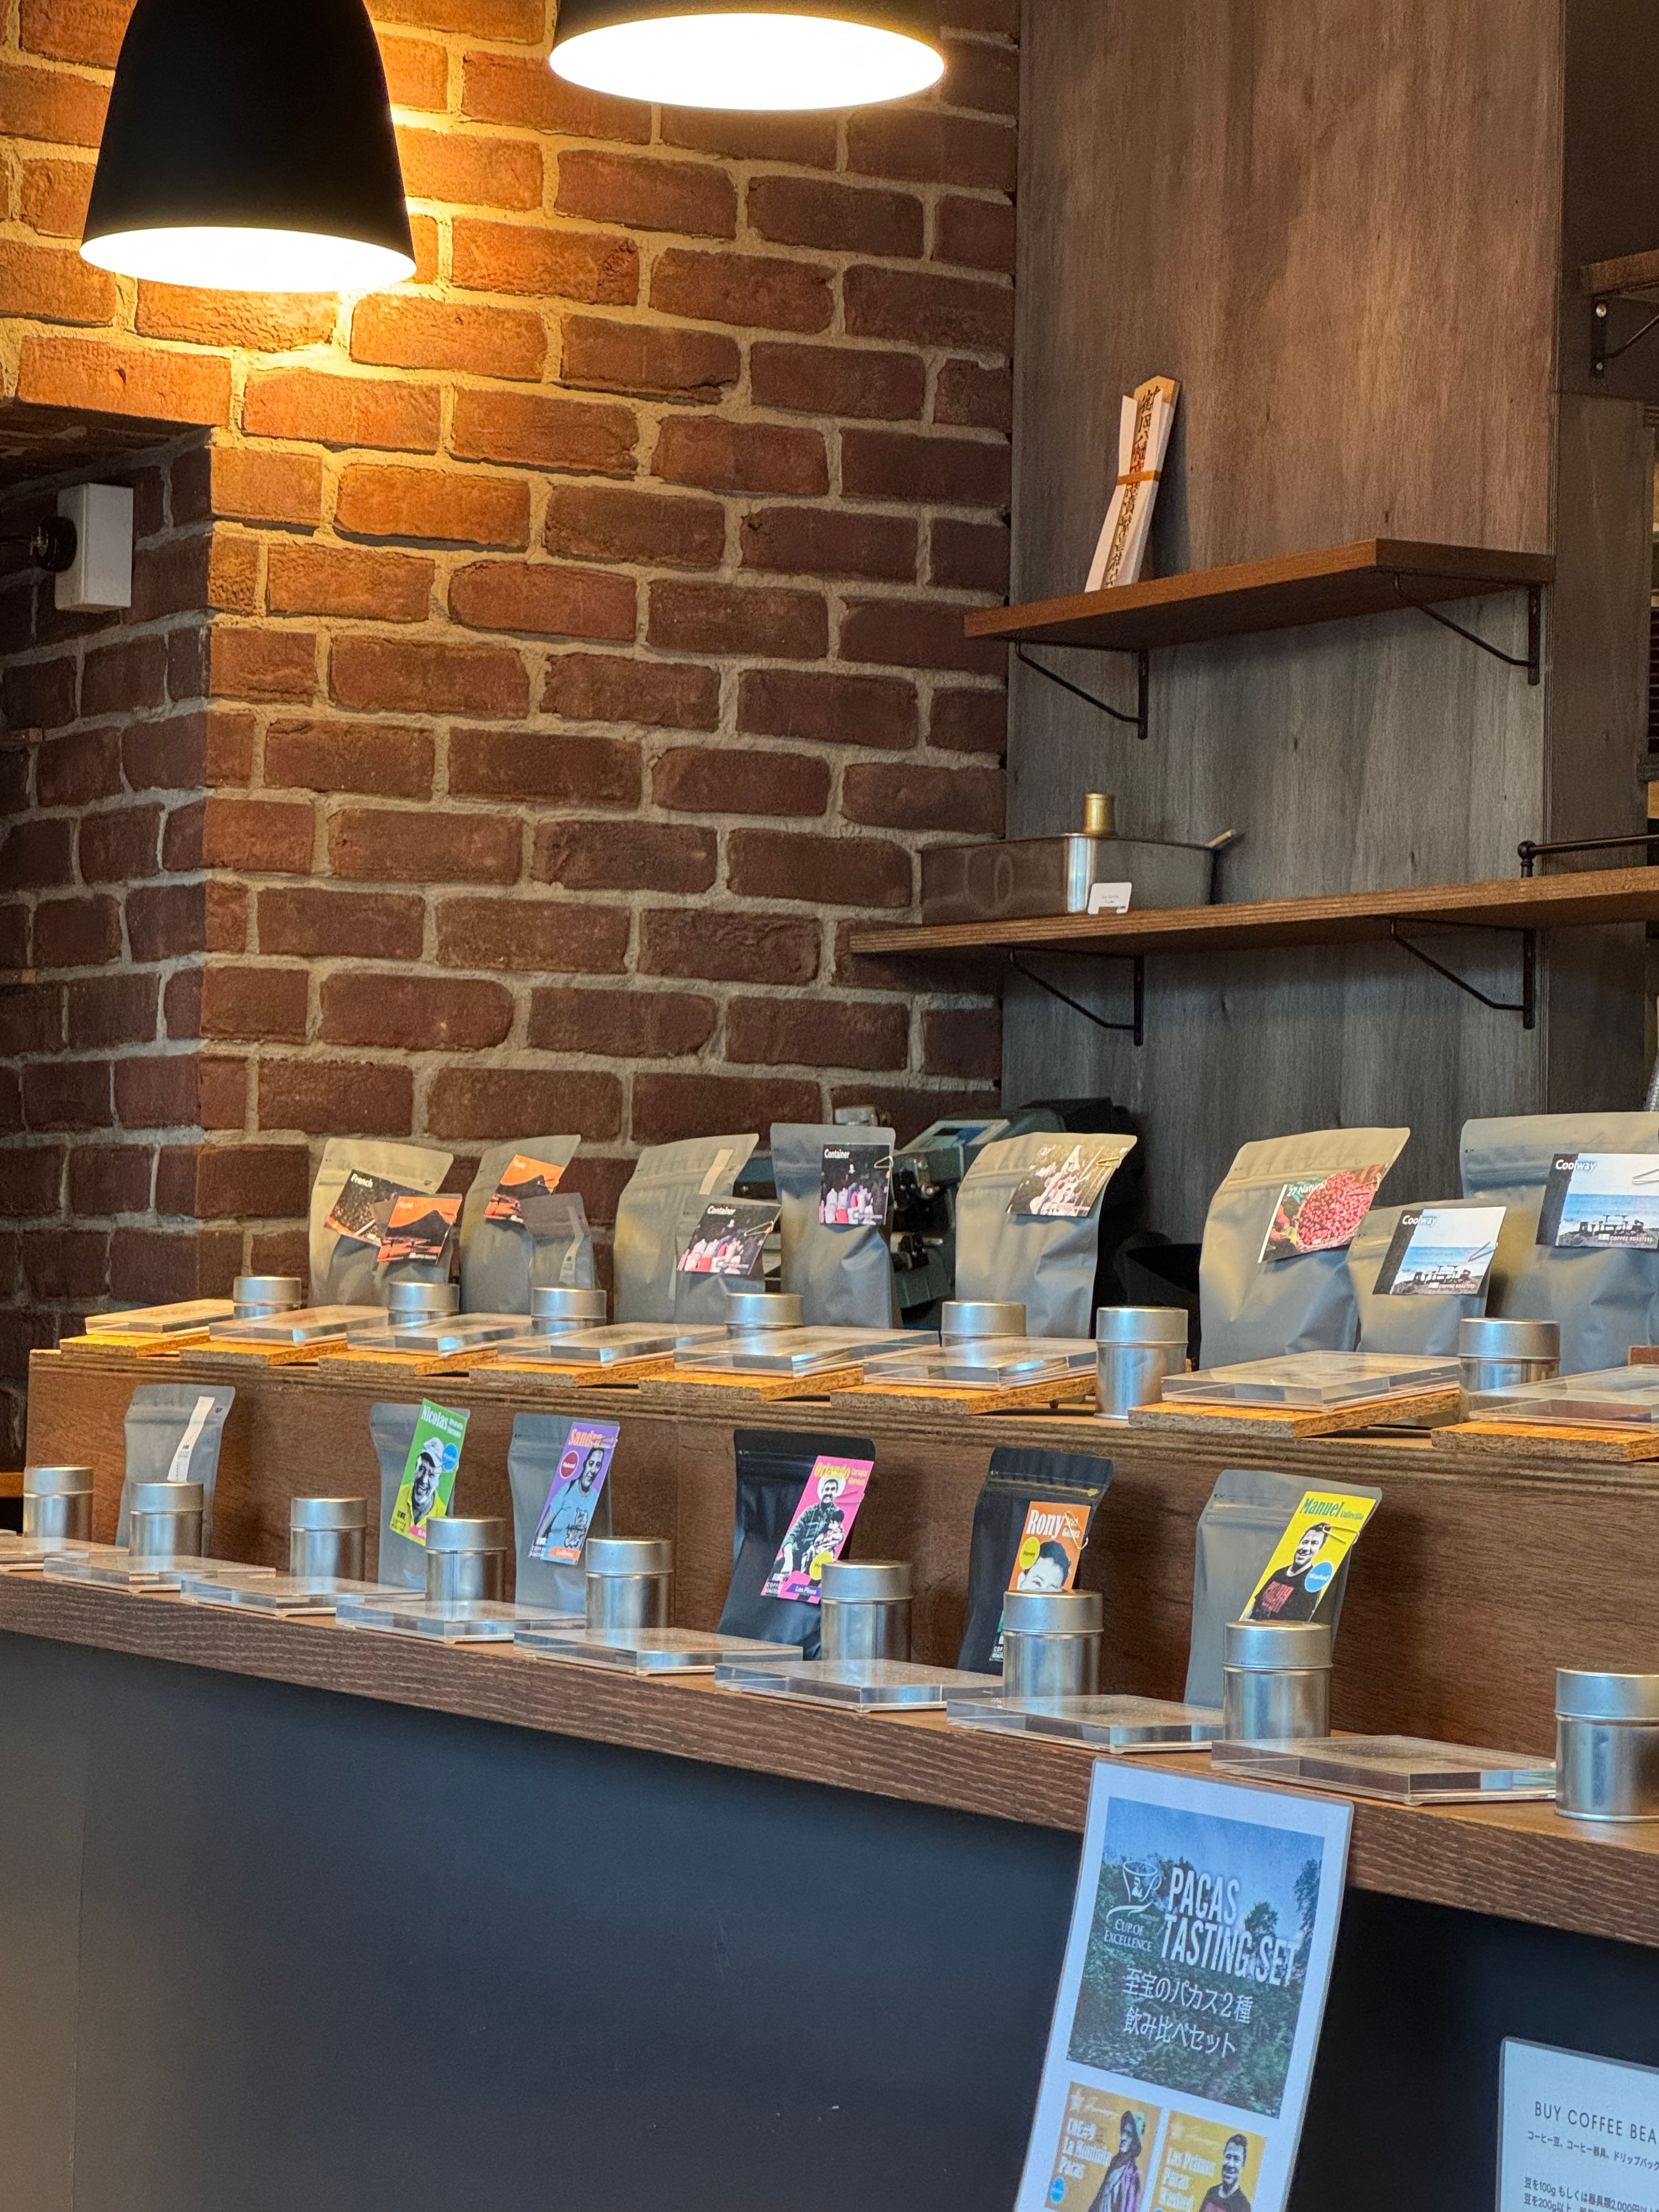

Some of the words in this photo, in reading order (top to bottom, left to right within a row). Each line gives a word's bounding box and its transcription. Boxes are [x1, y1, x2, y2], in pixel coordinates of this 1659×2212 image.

[824, 1148, 850, 1159] Container
[1555, 1159, 1596, 1173] Coolway
[350, 1173, 373, 1188] French
[1297, 1182, 1325, 1194] Natural
[707, 1205, 736, 1216] Container
[1402, 1214, 1438, 1227] Coolway
[421, 1404, 449, 1431] Nicolas
[814, 1462, 851, 1480] Orlando
[1299, 1498, 1345, 1517] Manuel
[1026, 1509, 1066, 1540] Rony
[1168, 1866, 1240, 1926] PACAS
[1115, 1918, 1133, 1933] CUP
[1132, 1924, 1146, 1937] OF
[1103, 1929, 1153, 1953] EXCELLENCE
[1161, 1913, 1252, 1978] TASTING
[1255, 1936, 1301, 1988] SET
[1122, 1967, 1254, 2024] 至宝のパカス2種
[1122, 2006, 1236, 2058] 飲み比べセット
[1534, 2101, 1561, 2121] BUY
[1567, 2109, 1623, 2137] COFFEE
[1524, 2177, 1556, 2197] 豆を100g
